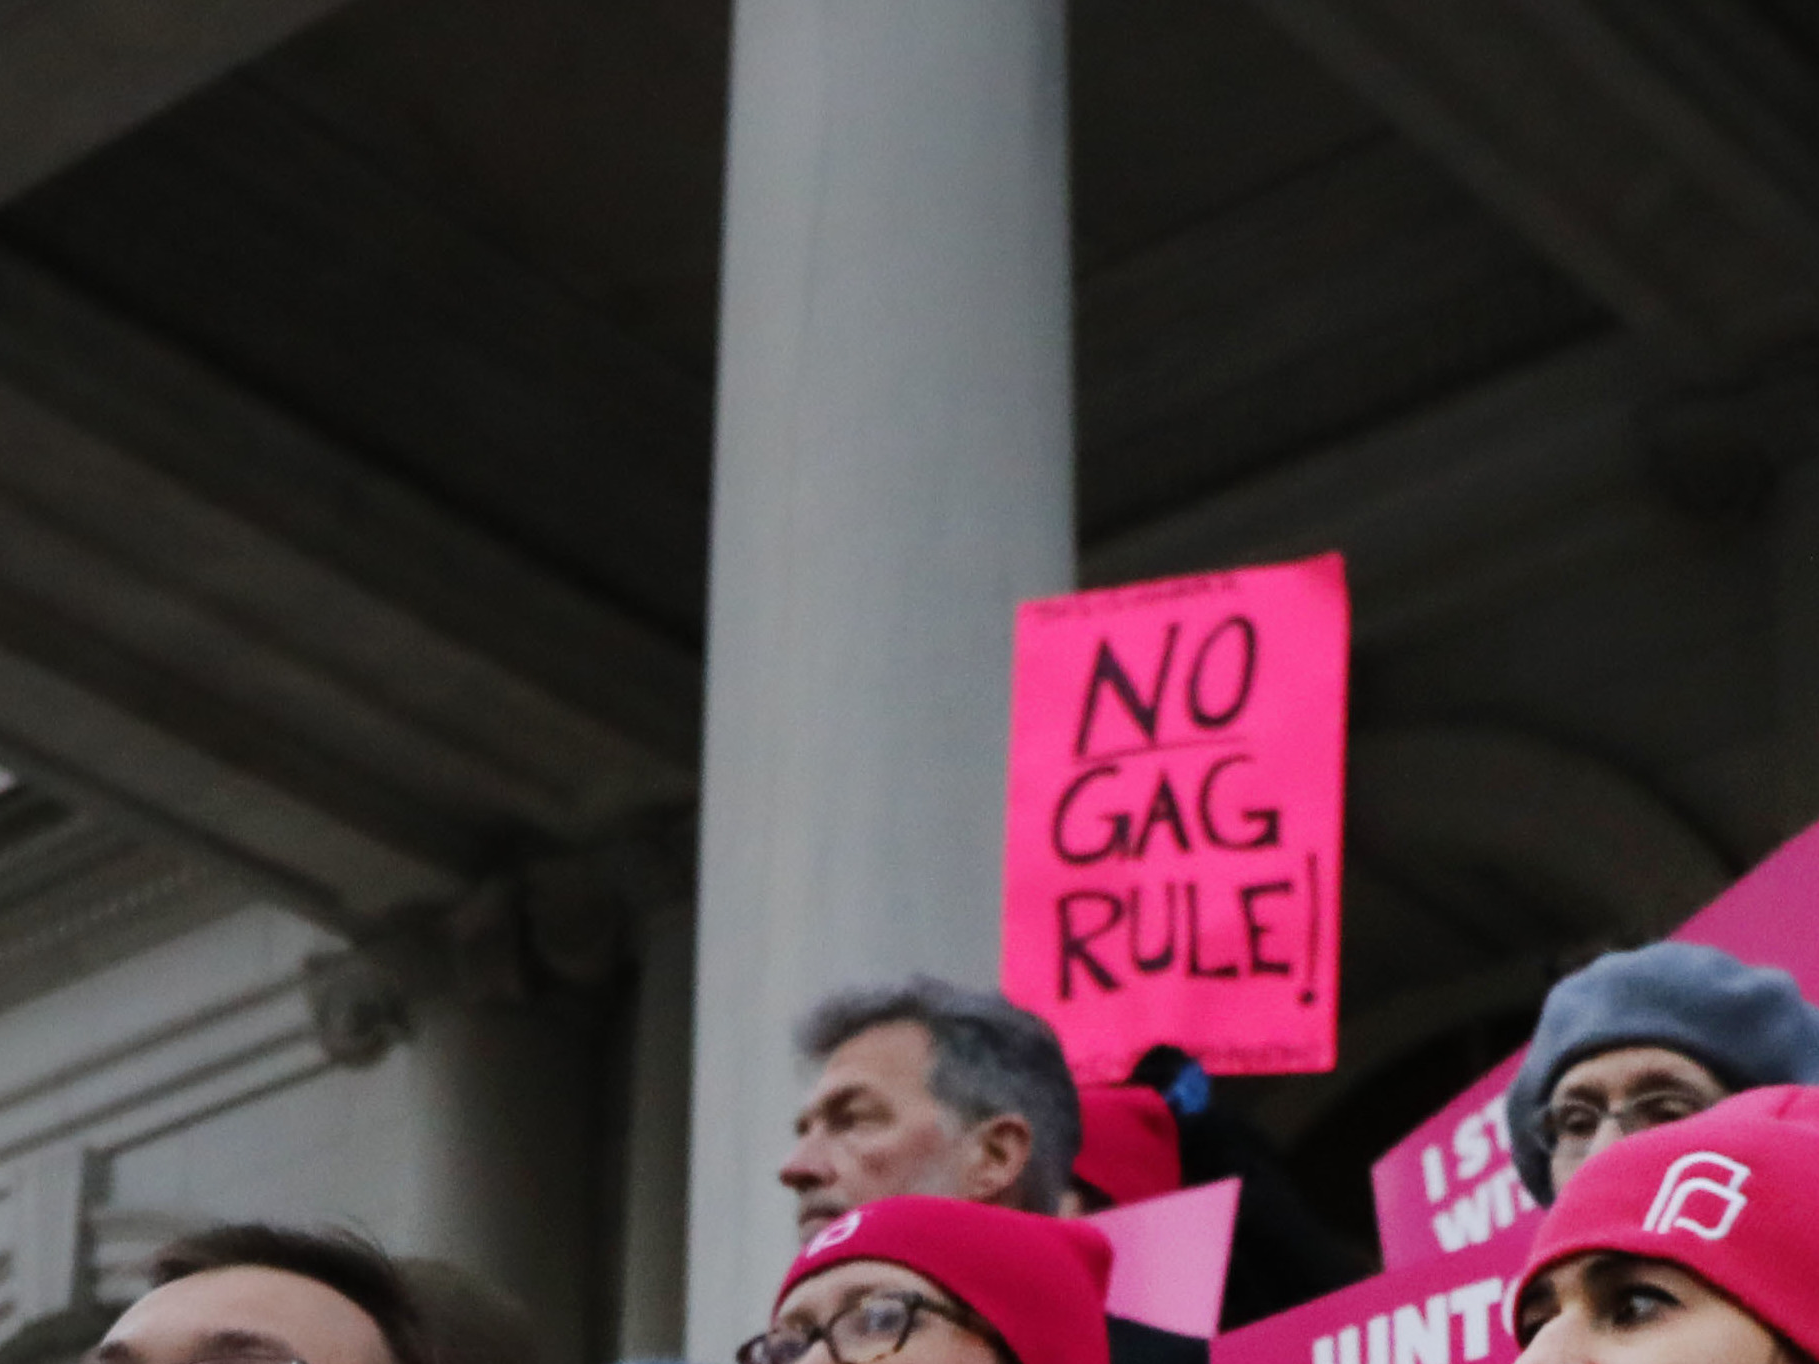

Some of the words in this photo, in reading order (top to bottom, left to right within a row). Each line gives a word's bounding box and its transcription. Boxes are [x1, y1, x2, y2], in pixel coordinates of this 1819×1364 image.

[1075, 614, 1258, 757] NO
[1052, 753, 1280, 864] GAG
[1057, 850, 1320, 1008] RULE!
[1422, 1145, 1446, 1203] I
